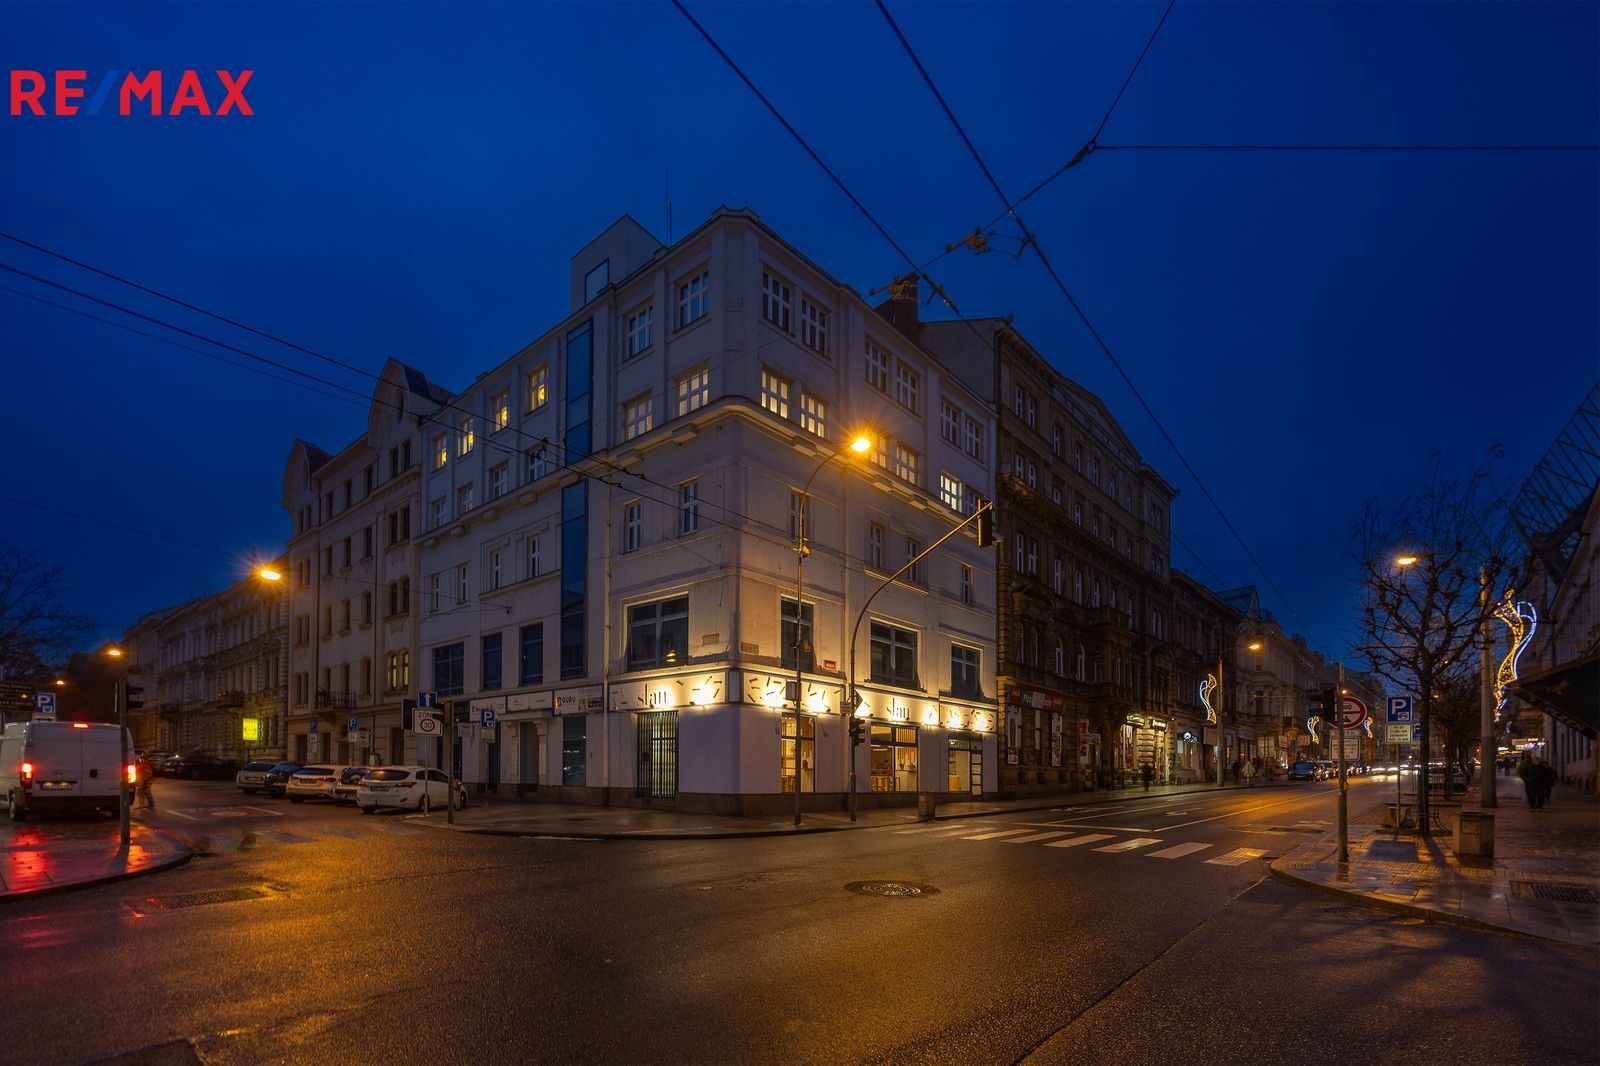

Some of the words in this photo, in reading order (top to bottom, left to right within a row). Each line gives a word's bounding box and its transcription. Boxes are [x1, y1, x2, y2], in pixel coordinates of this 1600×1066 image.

[37, 694, 50, 708] P
[1392, 698, 1407, 715] P
[484, 711, 492, 722] P
[423, 721, 432, 729] 30
